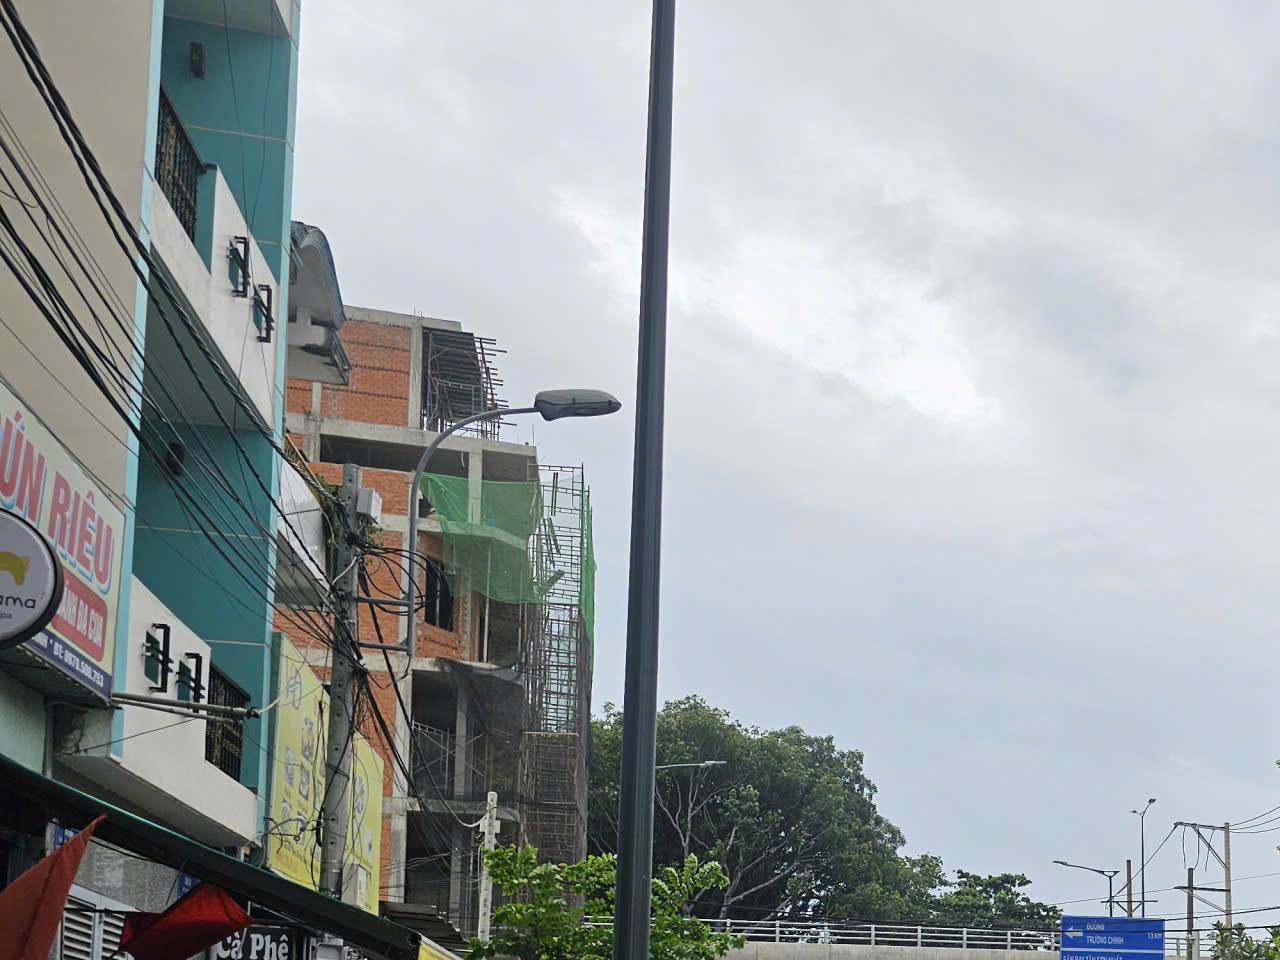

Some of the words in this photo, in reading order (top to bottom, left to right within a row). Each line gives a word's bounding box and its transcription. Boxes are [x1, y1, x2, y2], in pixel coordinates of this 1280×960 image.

[0, 410, 46, 525] ÚN
[48, 470, 115, 592] RIÊU
[1086, 933, 1107, 945] TRƯỜNG
[1107, 936, 1124, 945] CHINH
